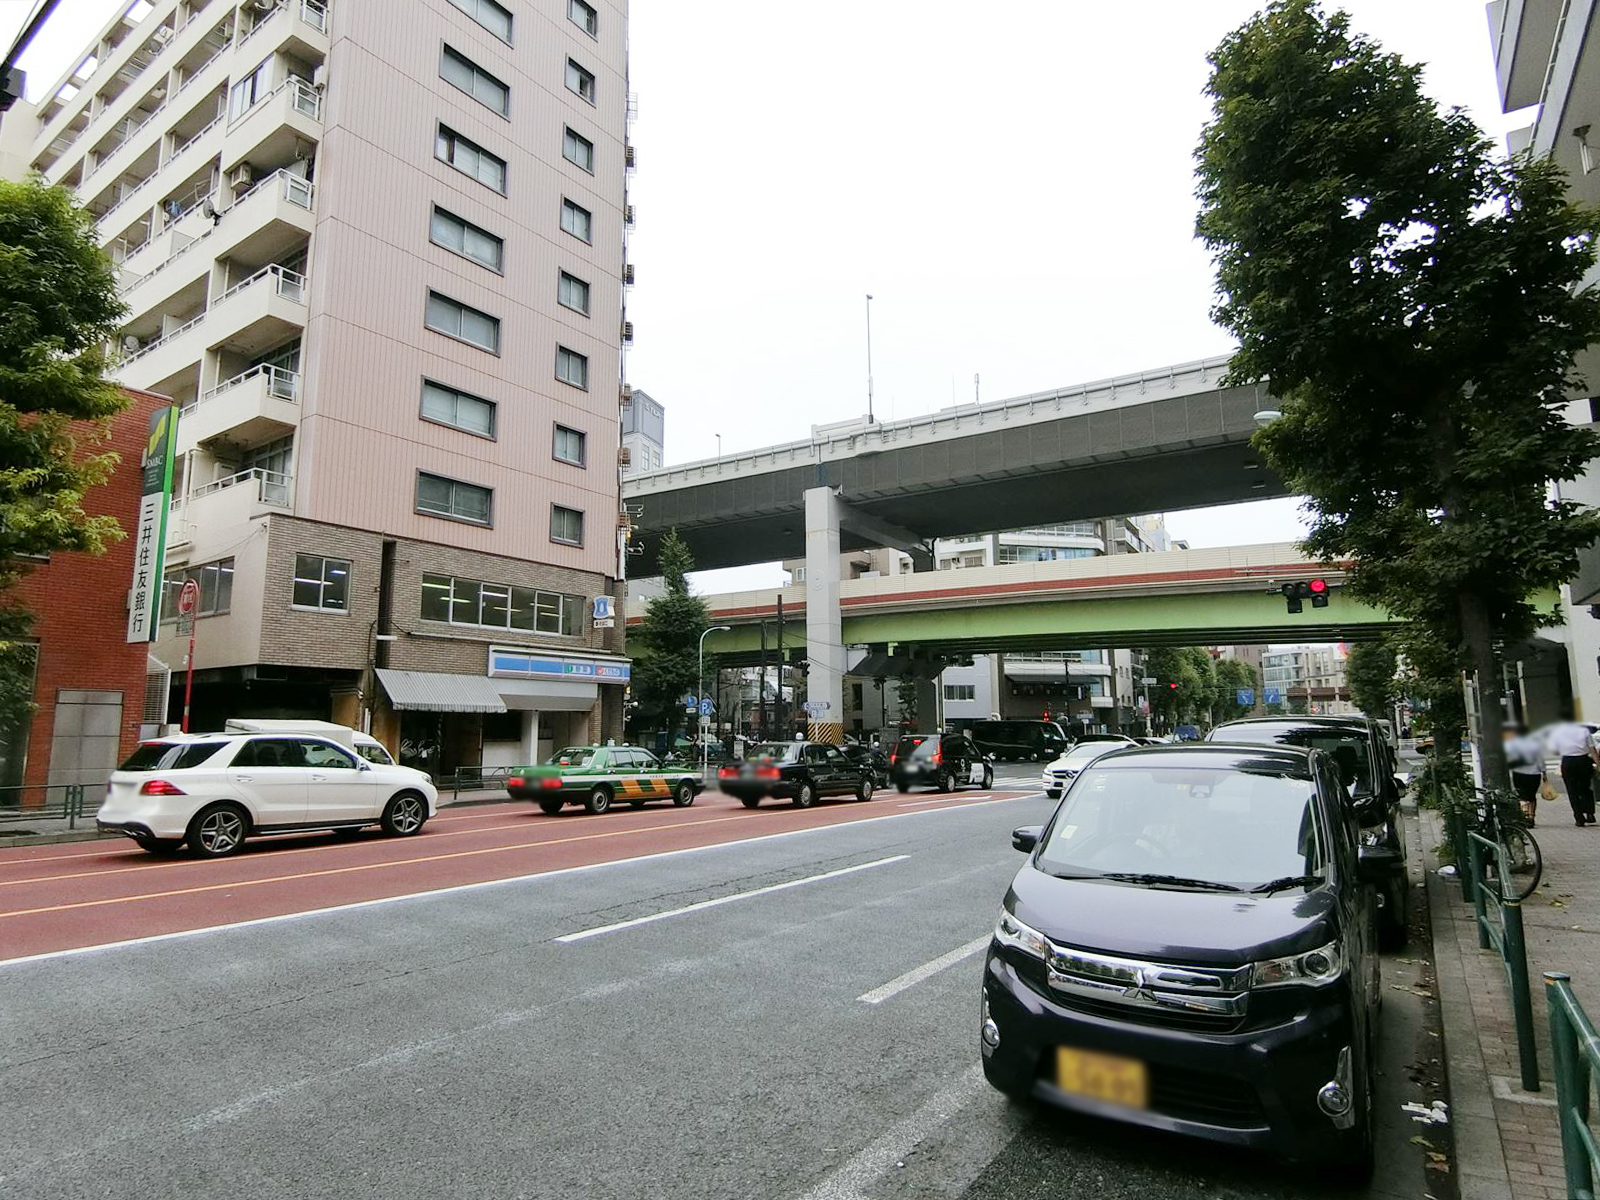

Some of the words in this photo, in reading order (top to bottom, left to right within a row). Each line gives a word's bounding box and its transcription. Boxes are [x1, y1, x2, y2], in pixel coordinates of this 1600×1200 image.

[132, 503, 155, 633] 三井住友銀行
[702, 703, 709, 714] P
